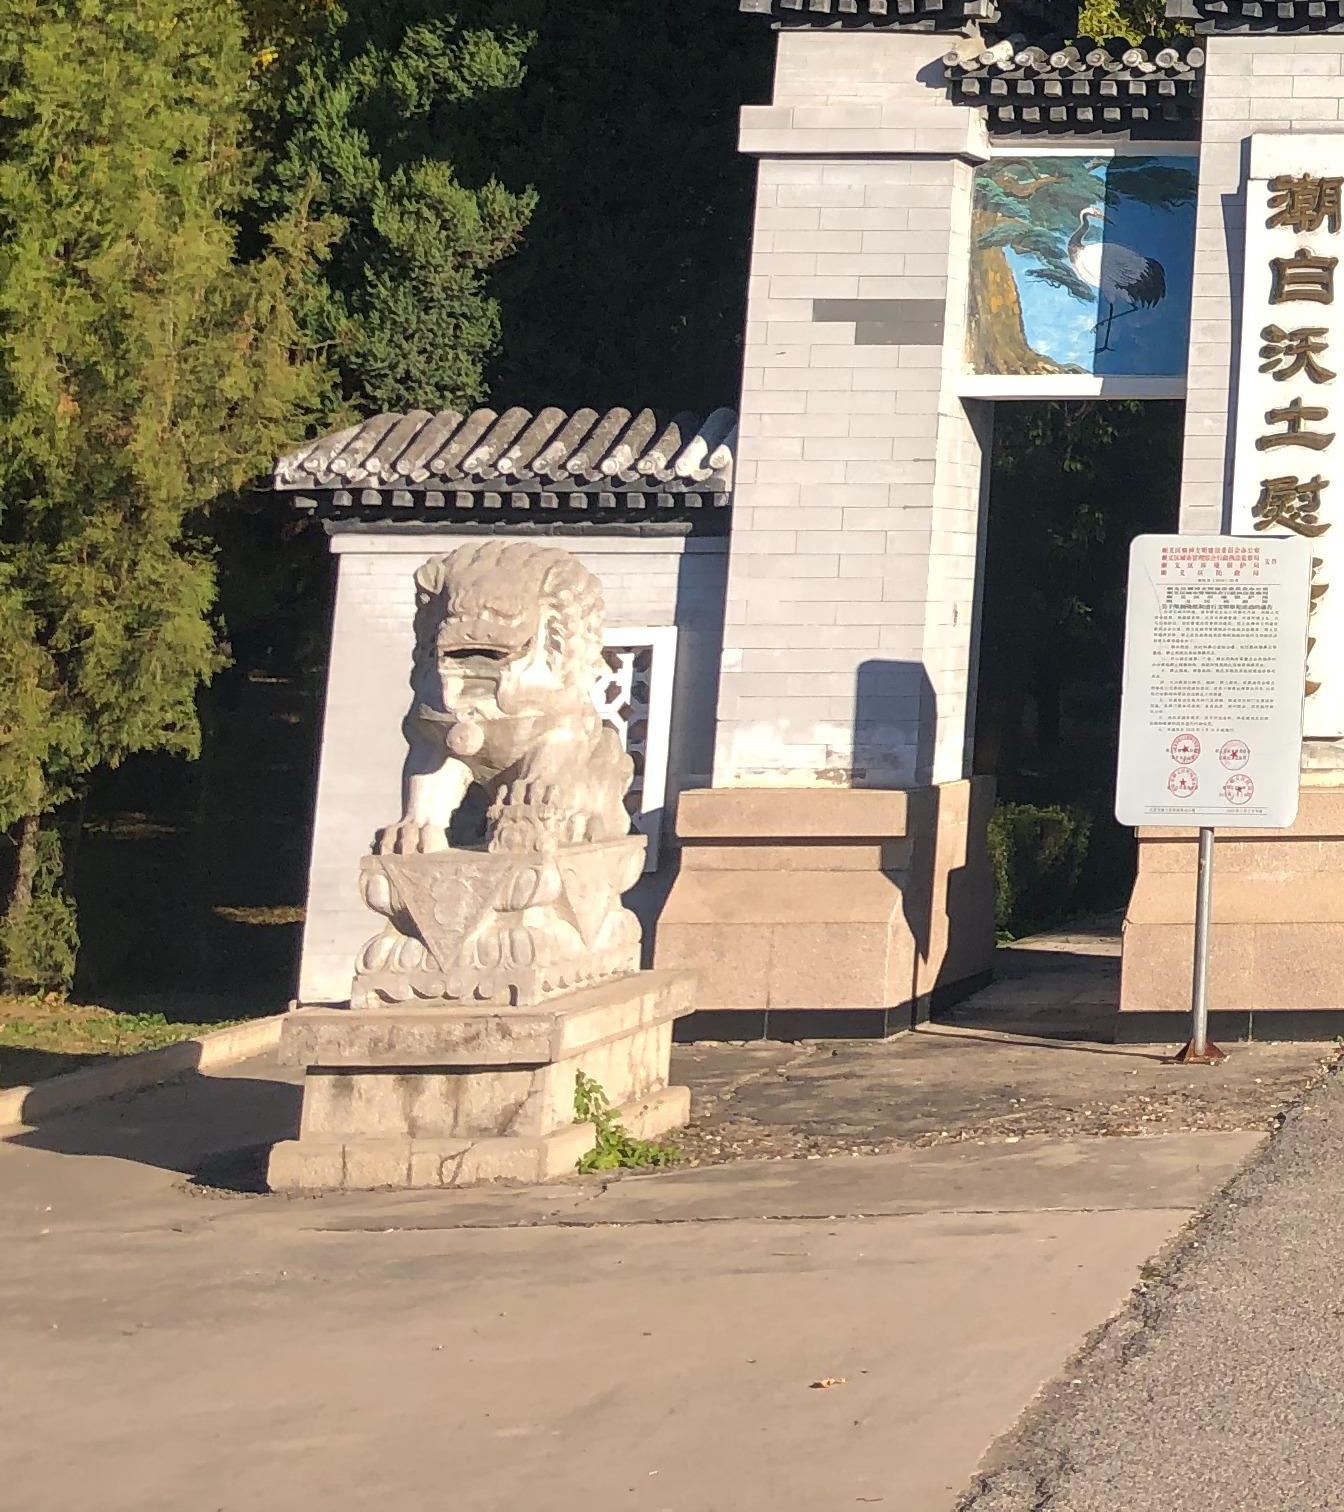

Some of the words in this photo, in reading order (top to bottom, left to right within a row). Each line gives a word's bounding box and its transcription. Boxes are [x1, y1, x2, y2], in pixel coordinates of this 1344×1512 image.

[1252, 173, 1343, 697] 潮白沃土慰
